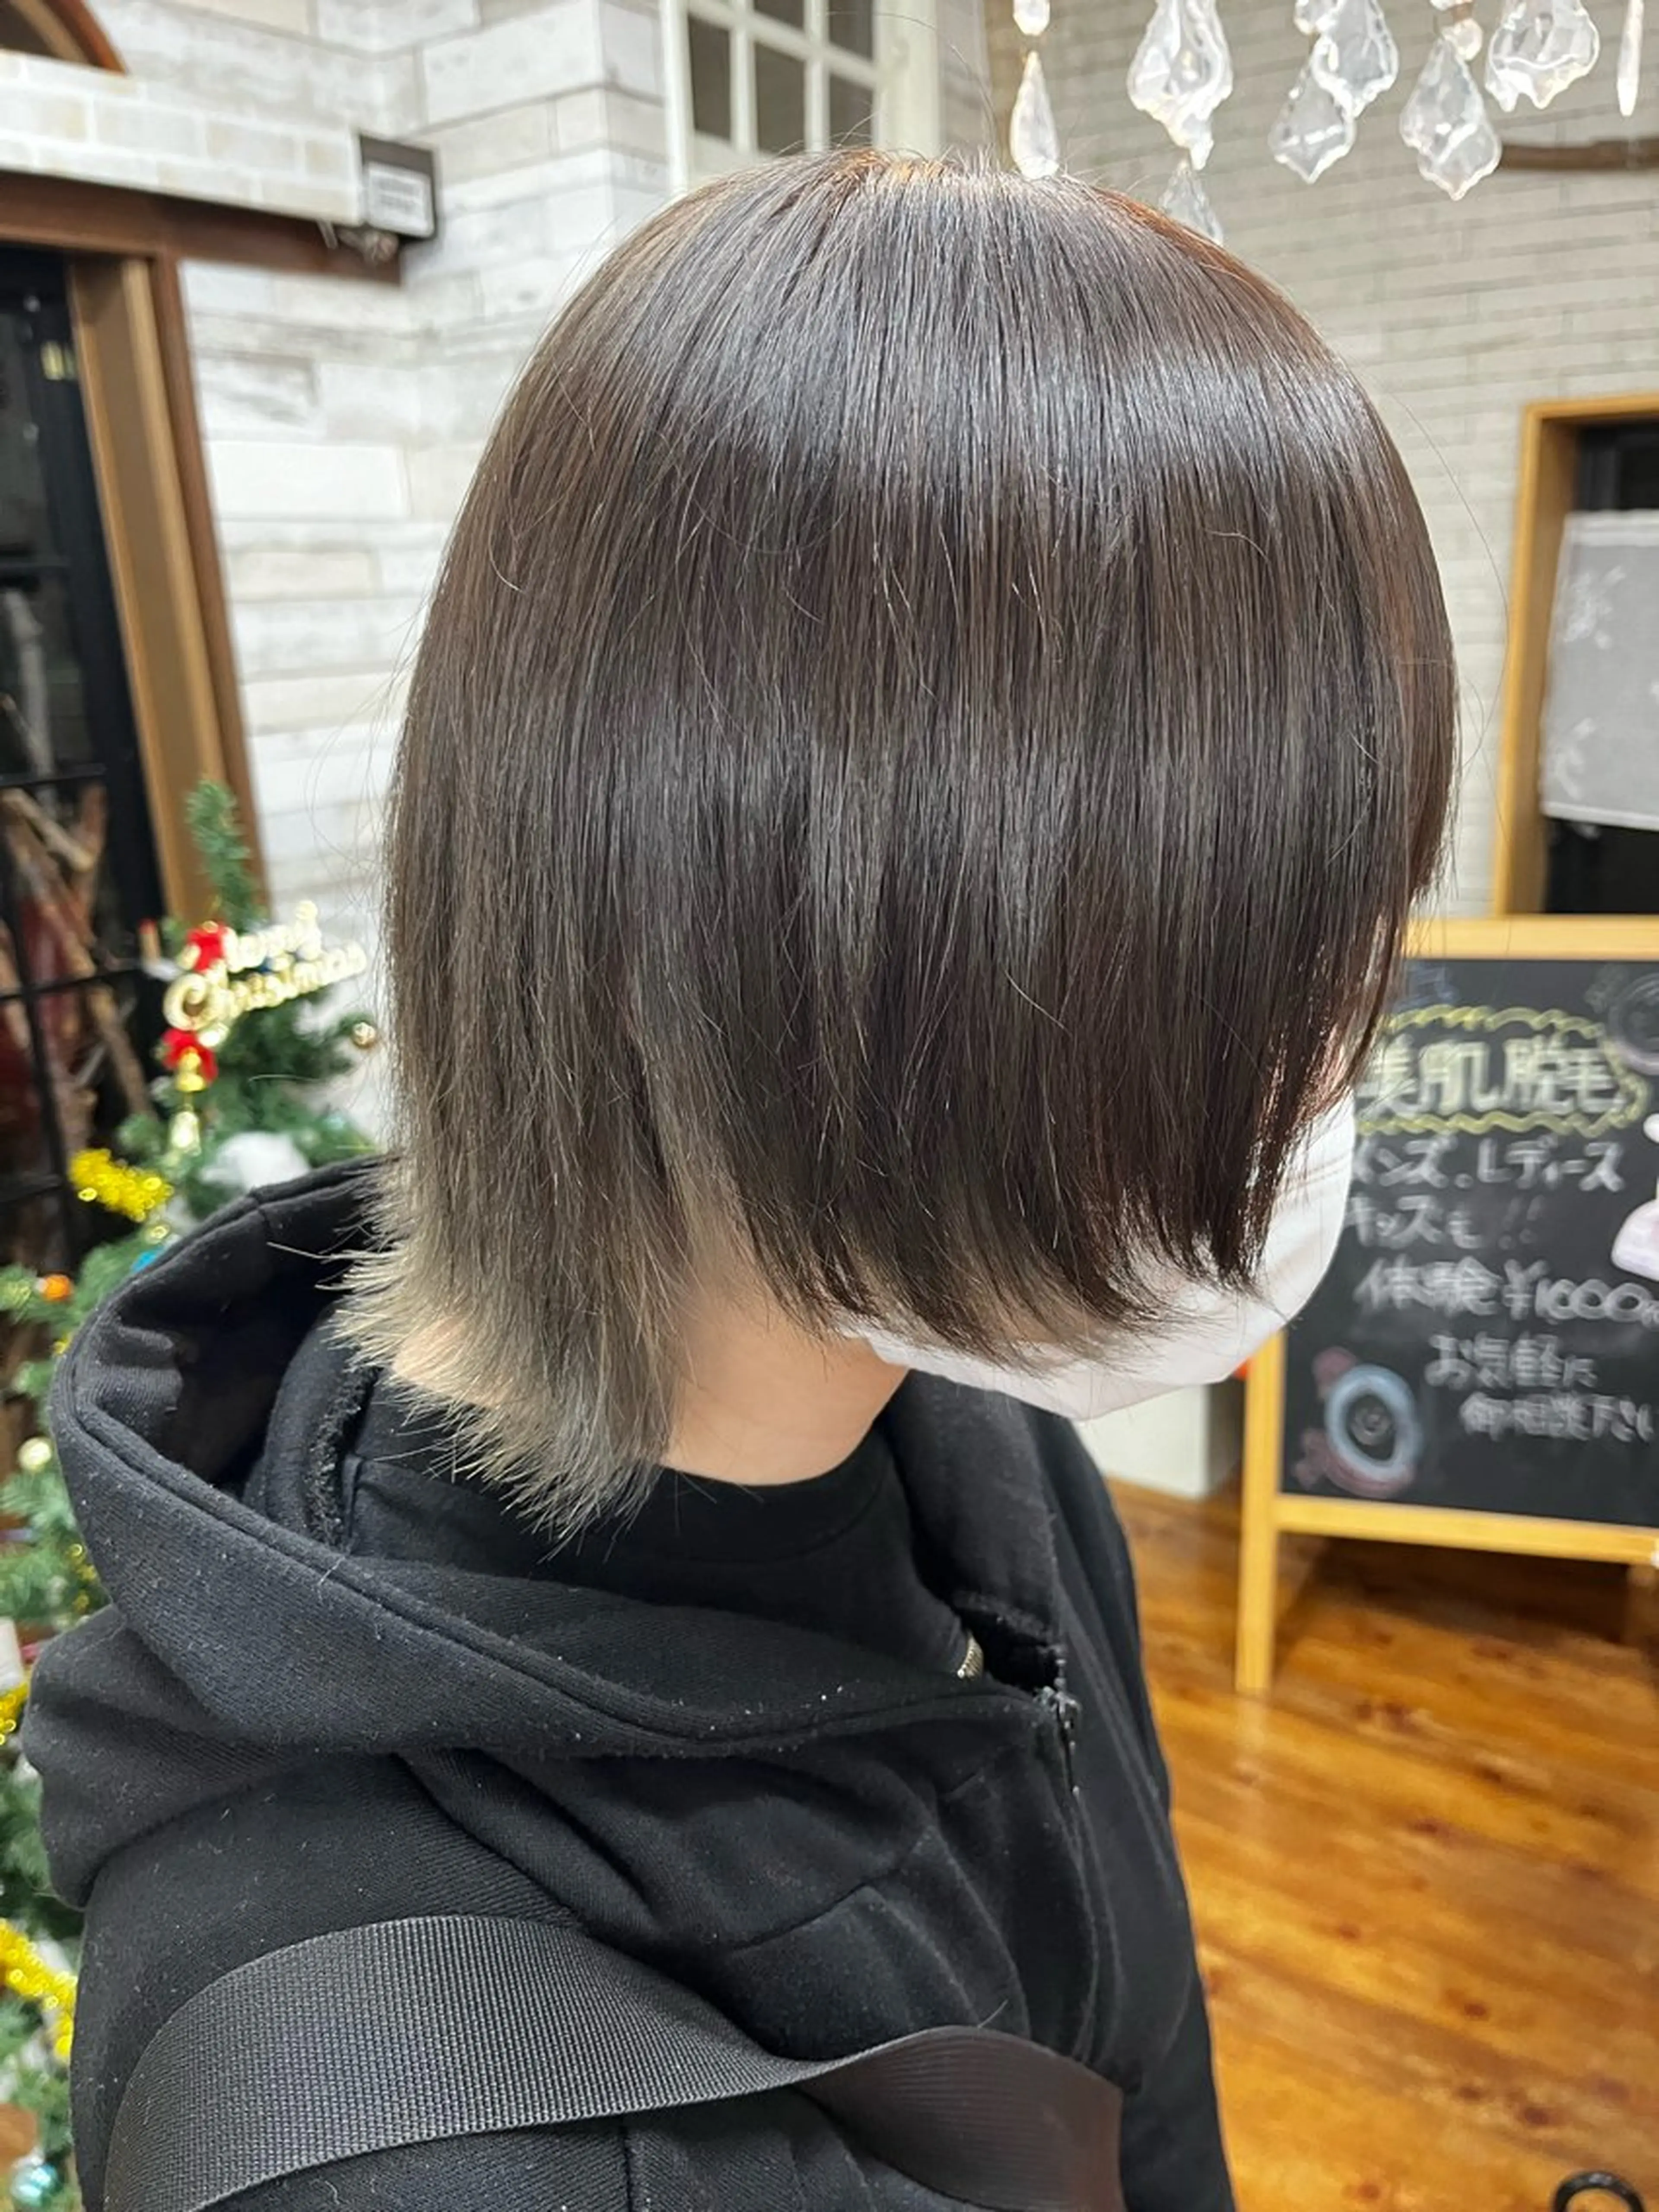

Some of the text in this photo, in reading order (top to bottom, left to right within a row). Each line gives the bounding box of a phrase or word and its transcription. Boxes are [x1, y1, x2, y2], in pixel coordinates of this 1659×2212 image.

[1356, 1033, 1623, 1117] 美肌脱毛
[1425, 1332, 1600, 1390] お気軽に
